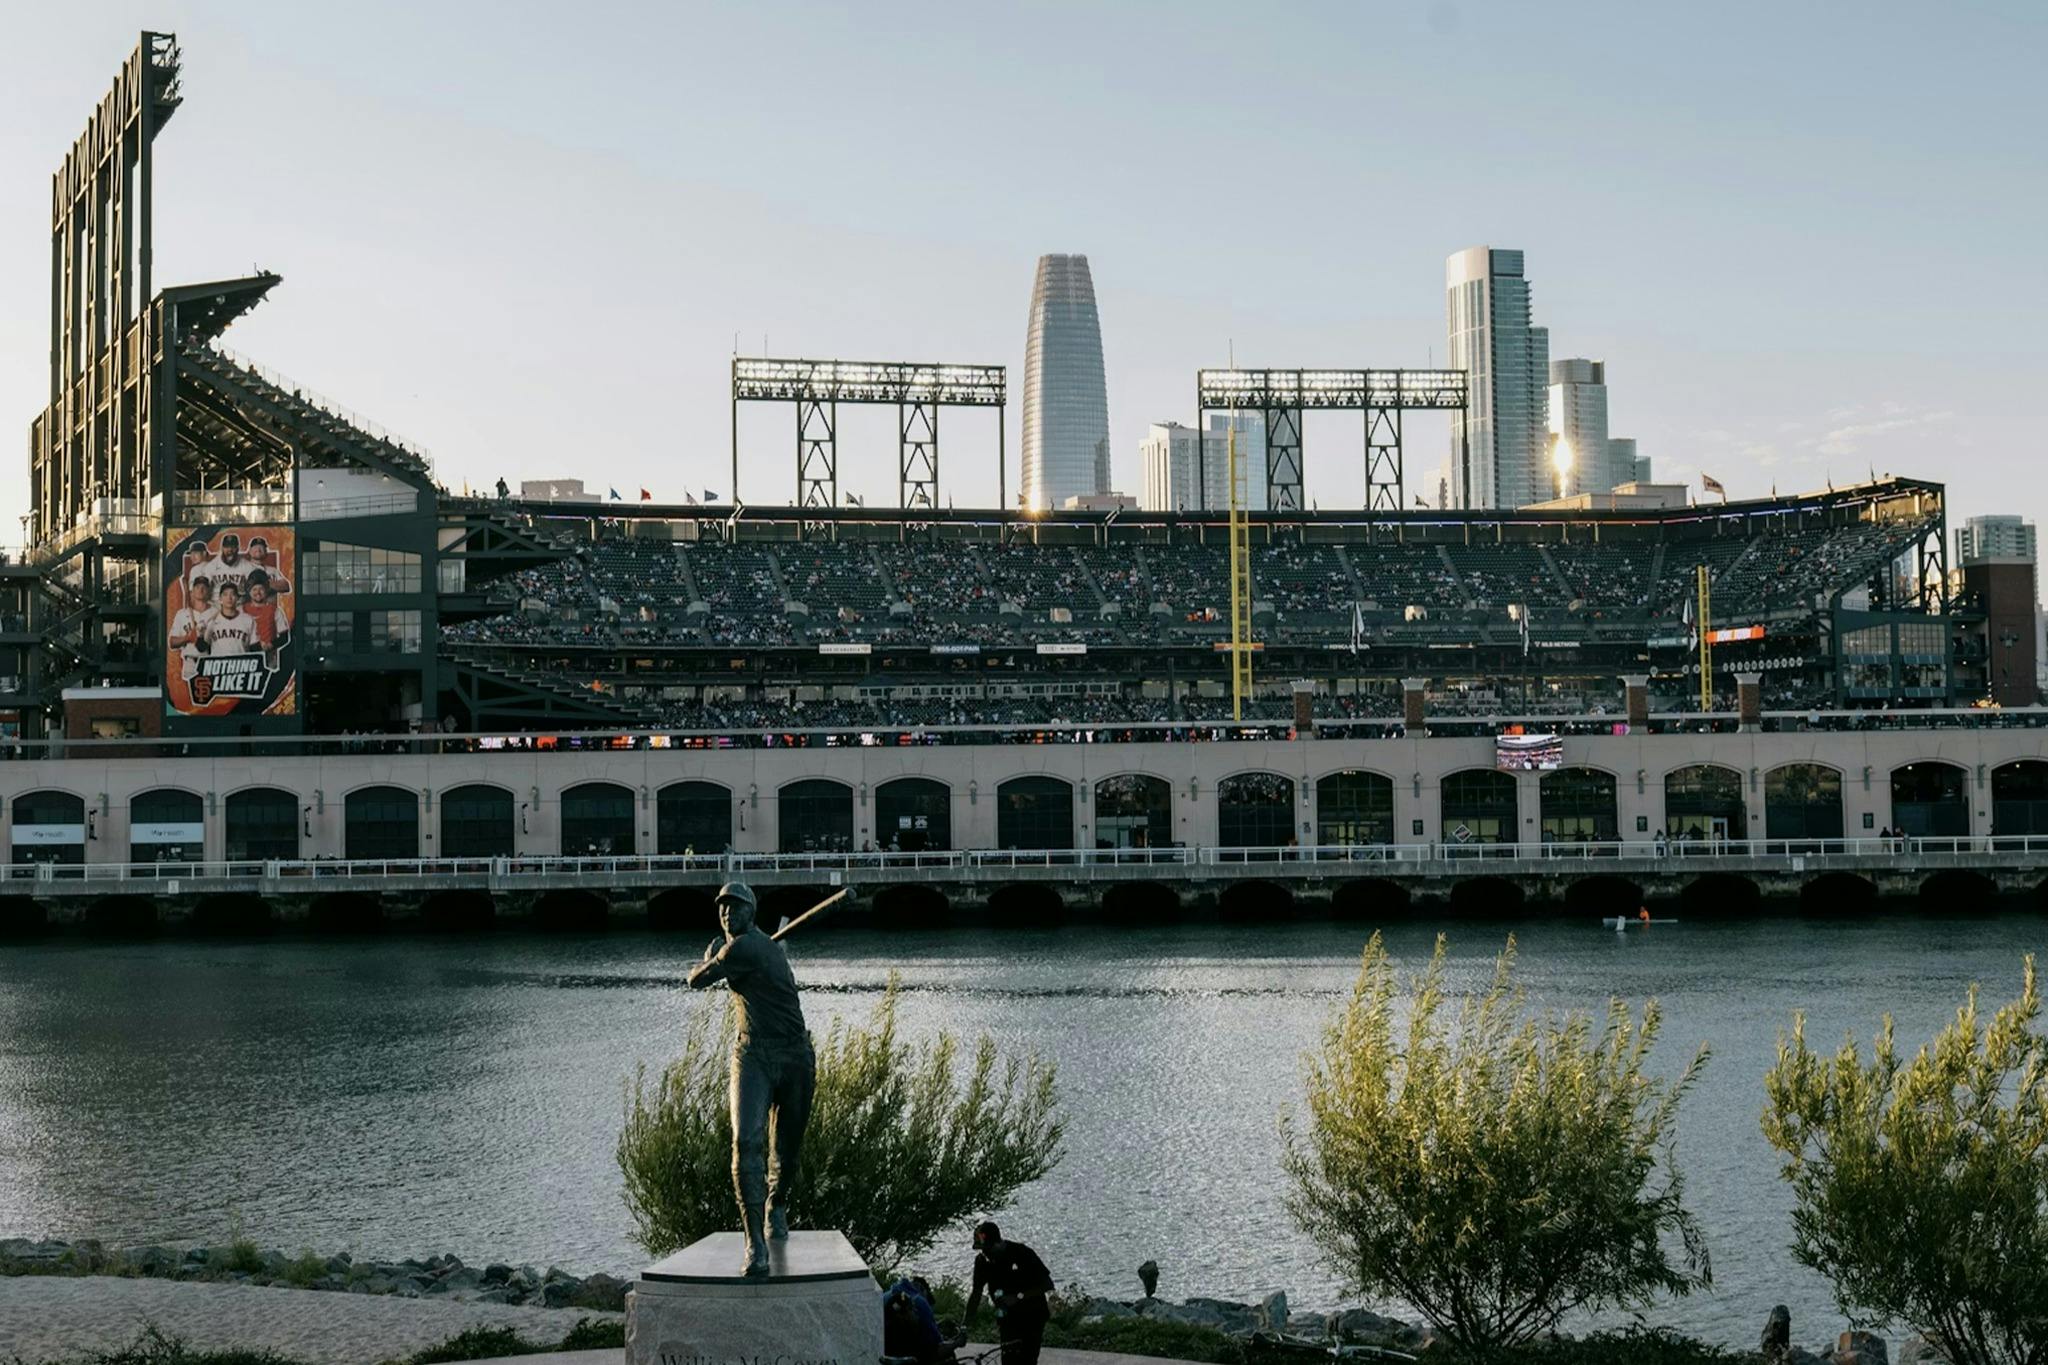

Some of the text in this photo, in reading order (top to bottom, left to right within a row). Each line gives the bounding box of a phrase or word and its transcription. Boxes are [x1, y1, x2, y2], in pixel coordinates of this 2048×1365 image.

[202, 658, 259, 676] NOTHING
[212, 671, 263, 691] LIKE IT
